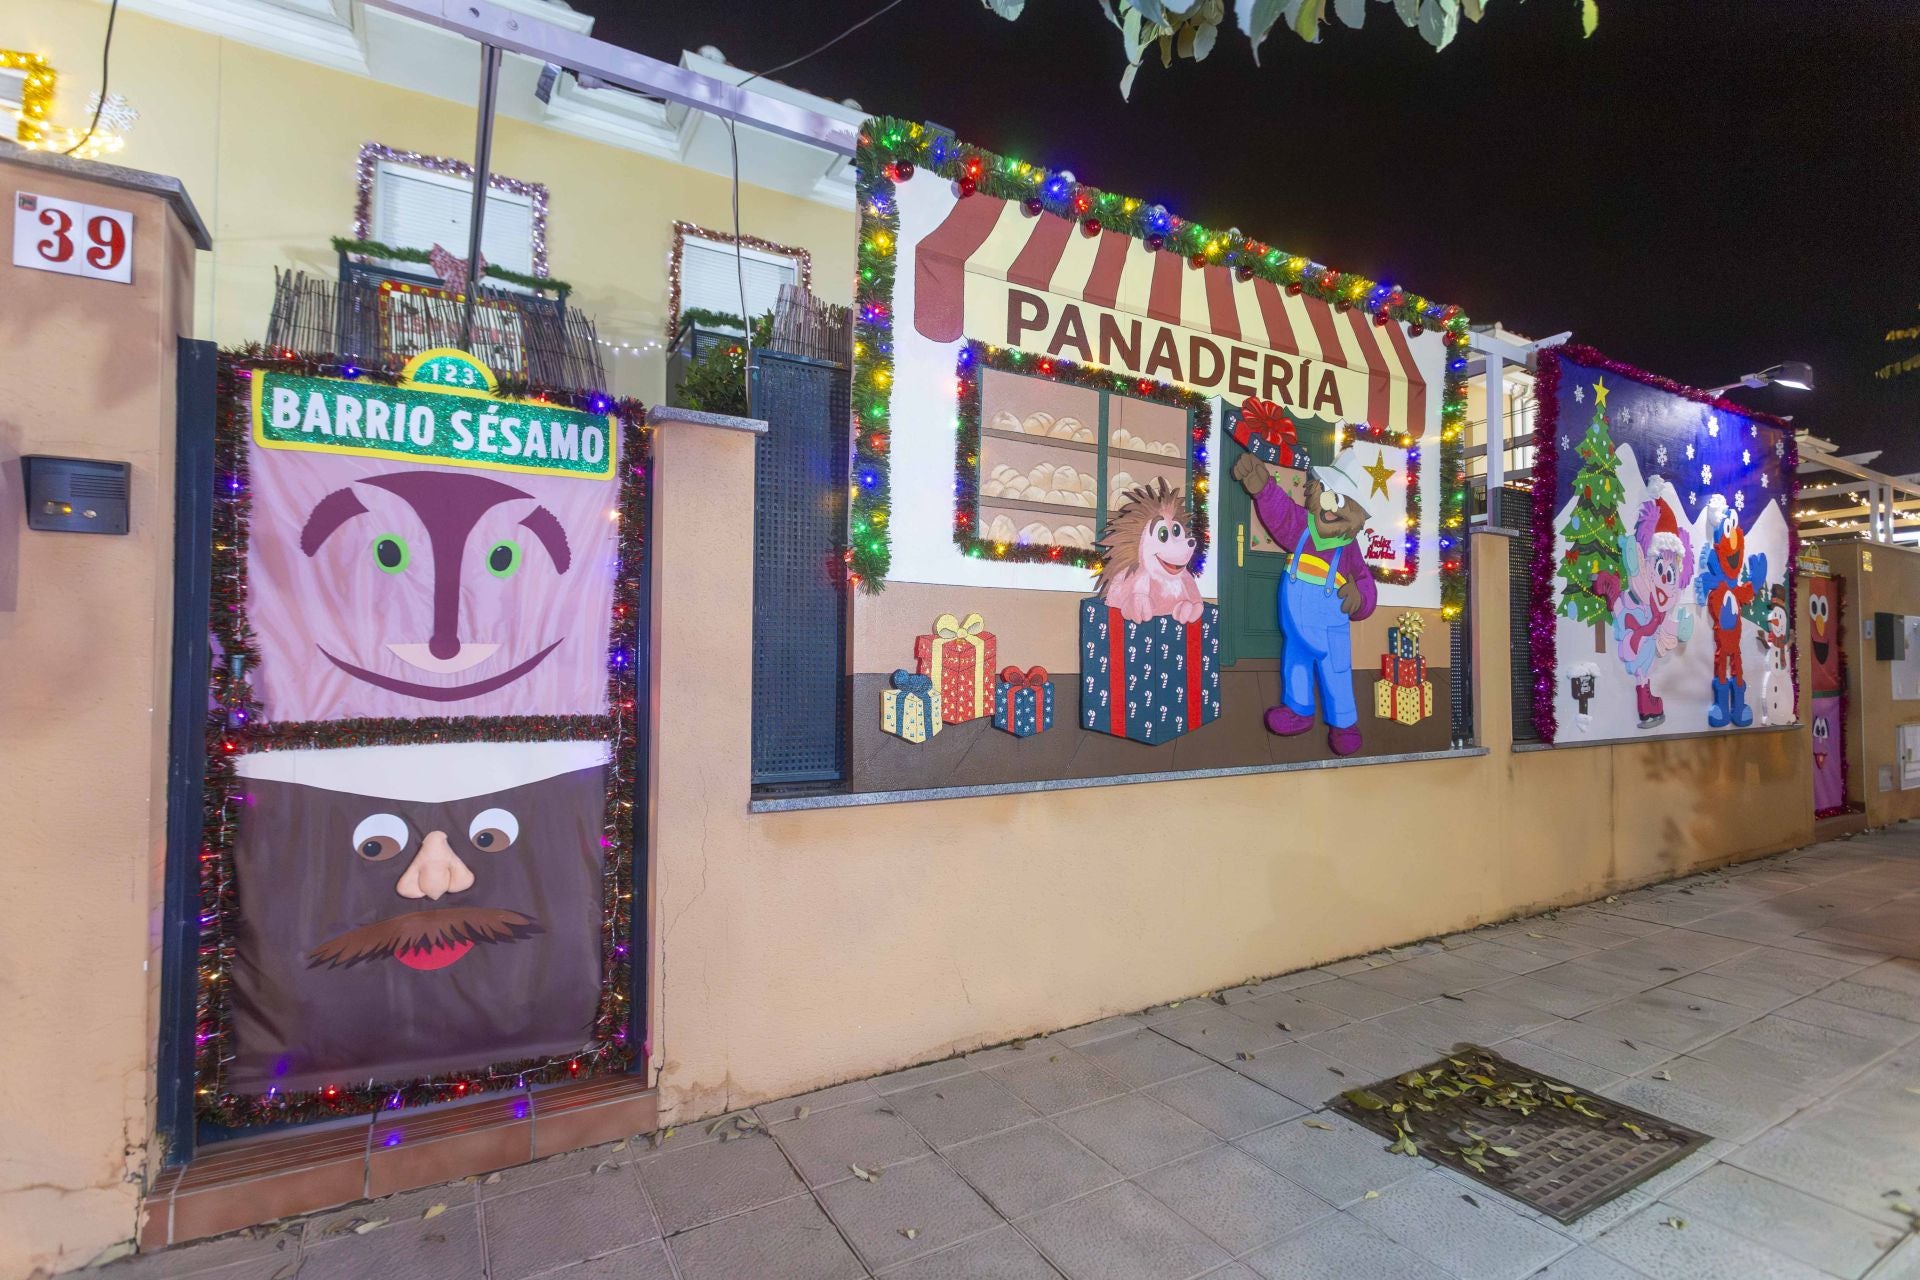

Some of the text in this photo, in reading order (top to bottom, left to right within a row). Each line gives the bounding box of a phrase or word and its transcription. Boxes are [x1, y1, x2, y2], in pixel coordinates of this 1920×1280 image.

[37, 208, 126, 270] 39
[429, 363, 475, 385] 123
[1006, 288, 1344, 417] PANADERÍA
[271, 386, 604, 464] BARRIO SÉSAMO
